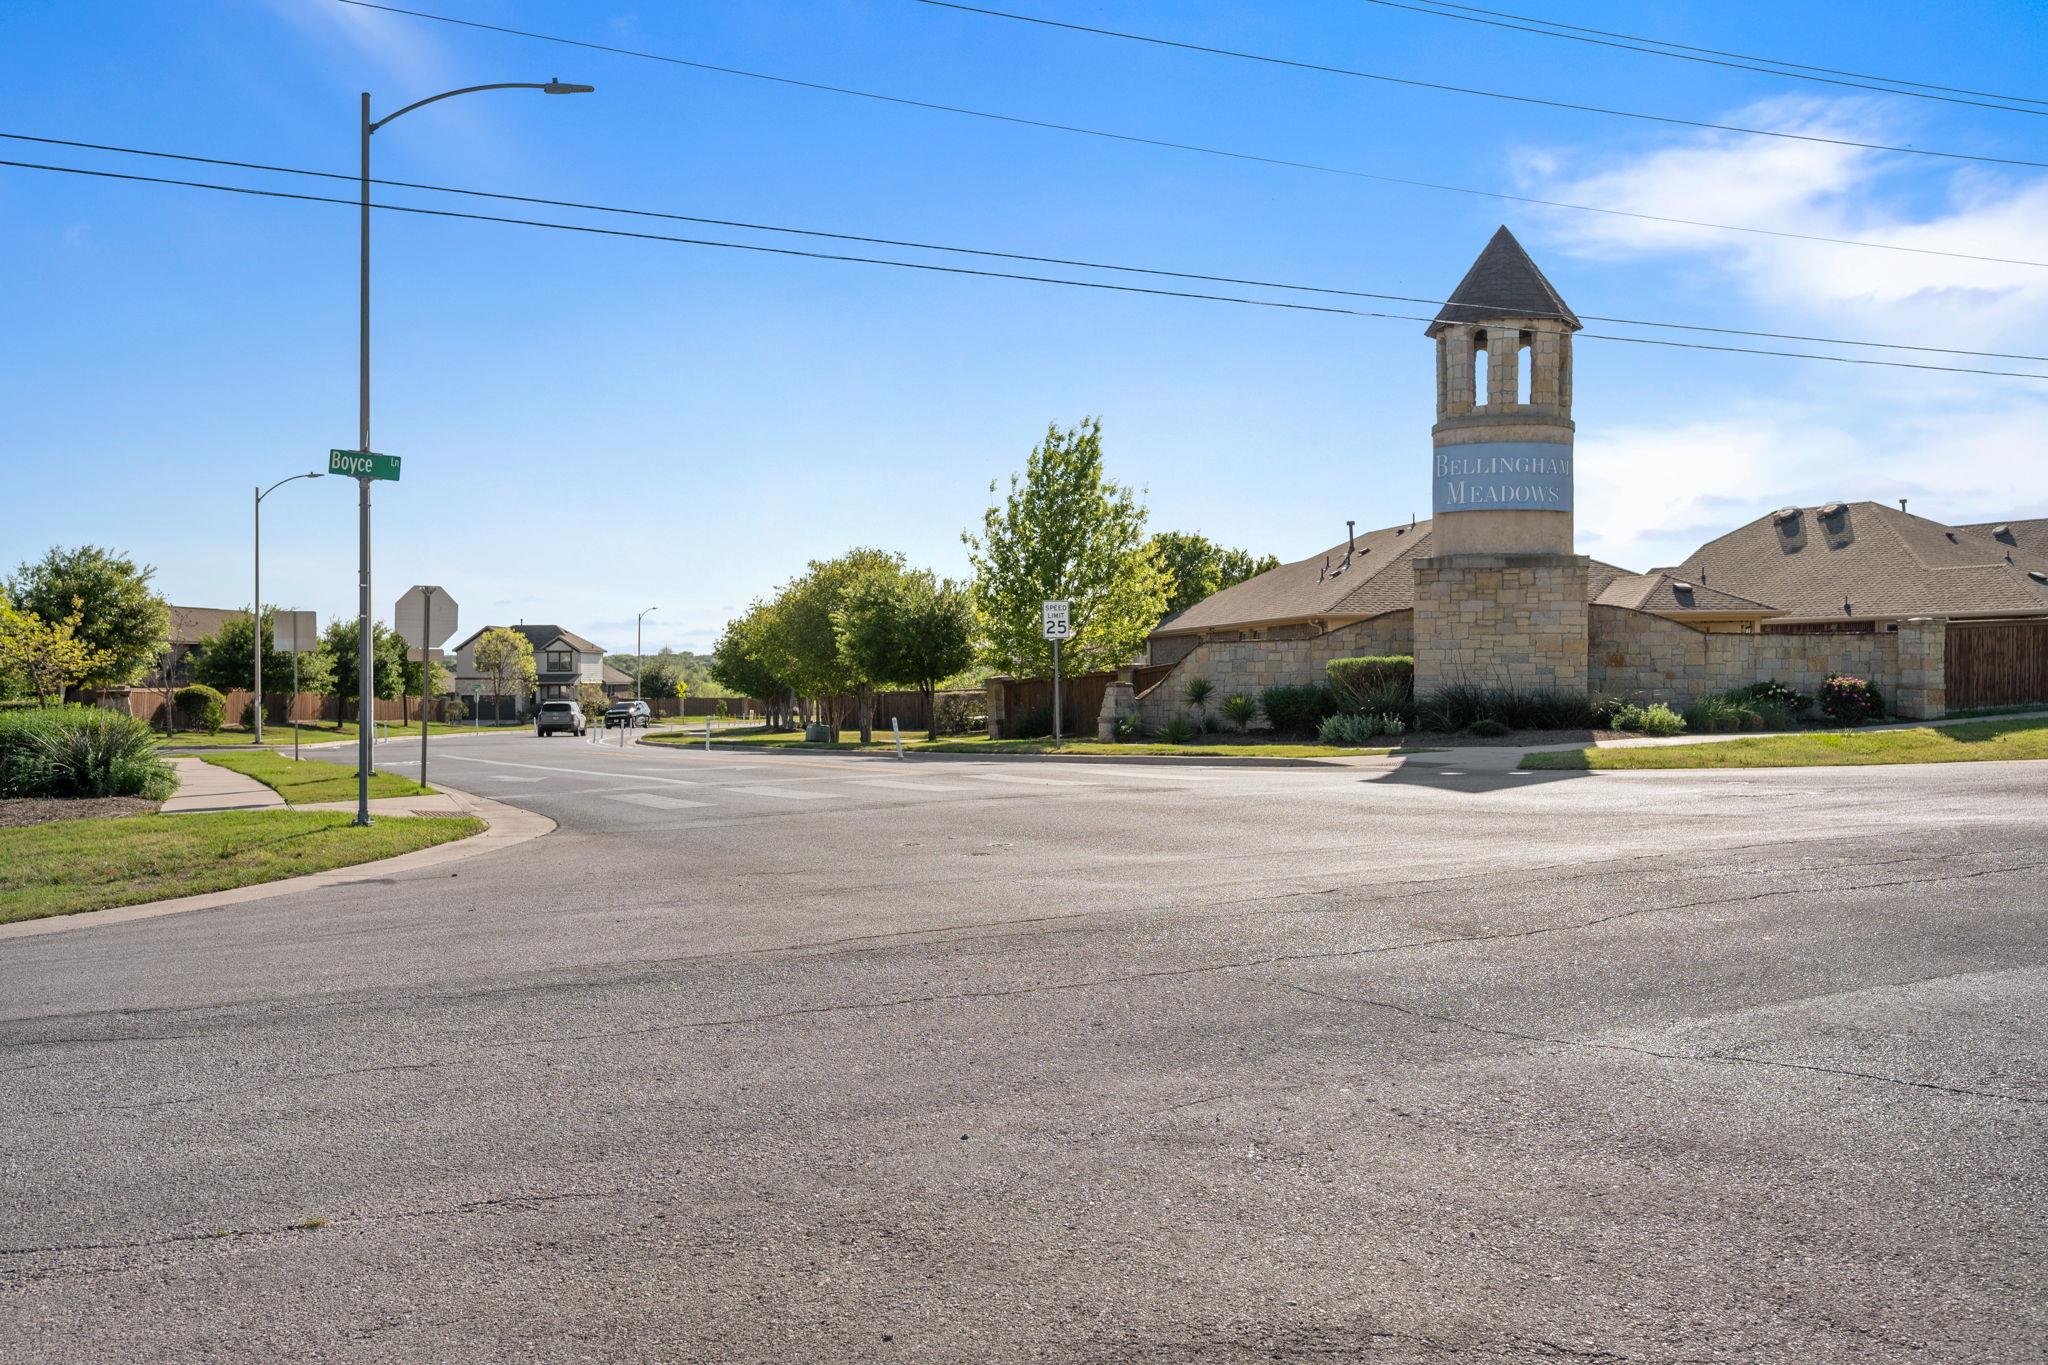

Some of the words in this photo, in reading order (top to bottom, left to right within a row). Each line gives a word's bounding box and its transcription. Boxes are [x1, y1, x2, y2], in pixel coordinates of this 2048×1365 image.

[331, 451, 373, 474] Boyce
[390, 457, 400, 467] Ln
[1437, 454, 1569, 478] BELLINGHAM
[1447, 481, 1559, 505] MEADOWS
[1046, 620, 1067, 634] 25
